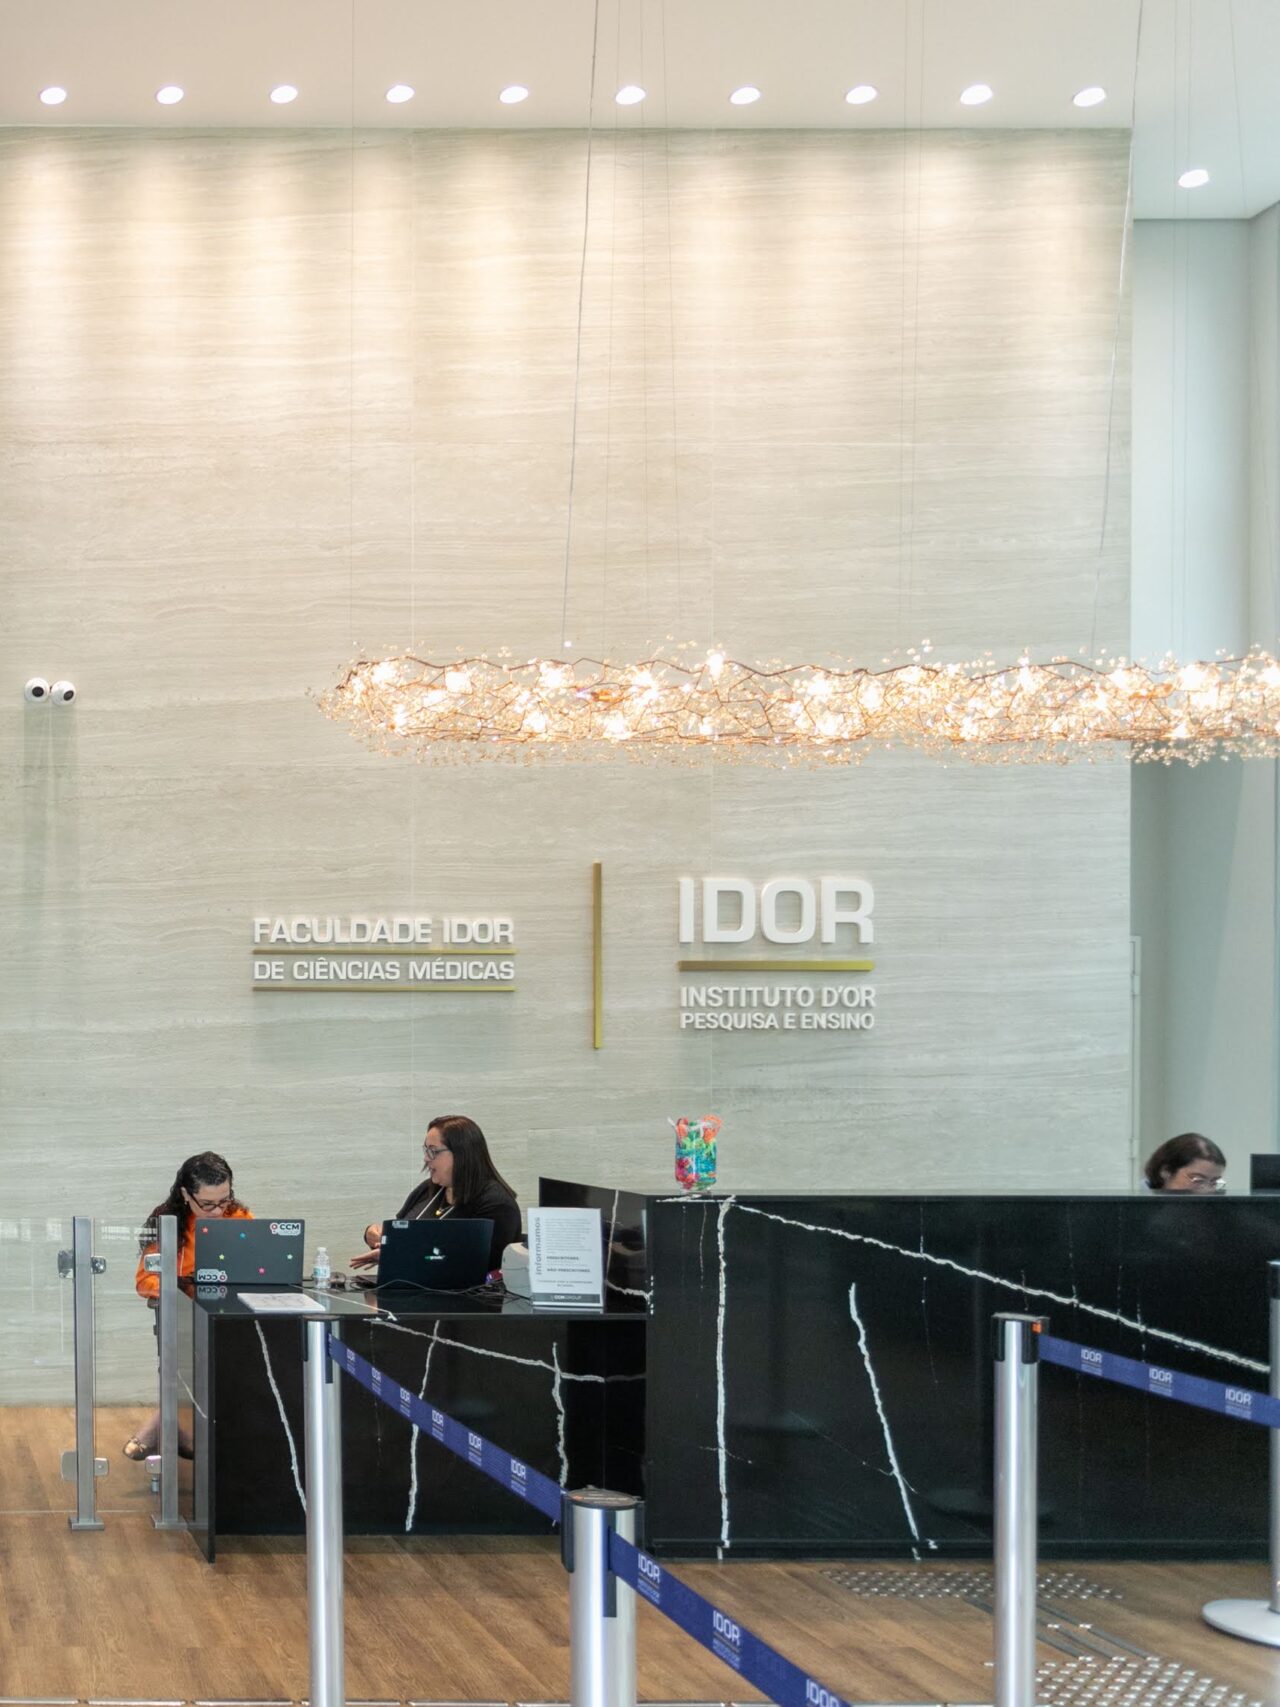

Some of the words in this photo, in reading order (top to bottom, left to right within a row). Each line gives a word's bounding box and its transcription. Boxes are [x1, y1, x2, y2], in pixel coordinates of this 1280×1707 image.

[678, 878, 875, 944] IDOR
[253, 917, 433, 943] FACULDADE
[443, 917, 514, 943] IDOR
[253, 960, 284, 980] DE
[293, 956, 401, 980] CIÊNCIAS
[409, 957, 516, 980] MÉDICAS
[680, 986, 814, 1008] INSTITUTO
[822, 986, 876, 1008] D'OR
[680, 1012, 779, 1031] PESQUISA
[783, 1012, 797, 1029] E
[801, 1012, 876, 1030] ENSINO
[280, 1223, 300, 1231] CCM
[534, 1217, 543, 1275] informamos
[1081, 1348, 1103, 1364] IDOR
[1149, 1367, 1173, 1384] IDOR
[1225, 1387, 1252, 1406] IDOR
[511, 1457, 526, 1480] IDOR
[637, 1552, 661, 1584] IDOR
[713, 1609, 741, 1647] IDOR
